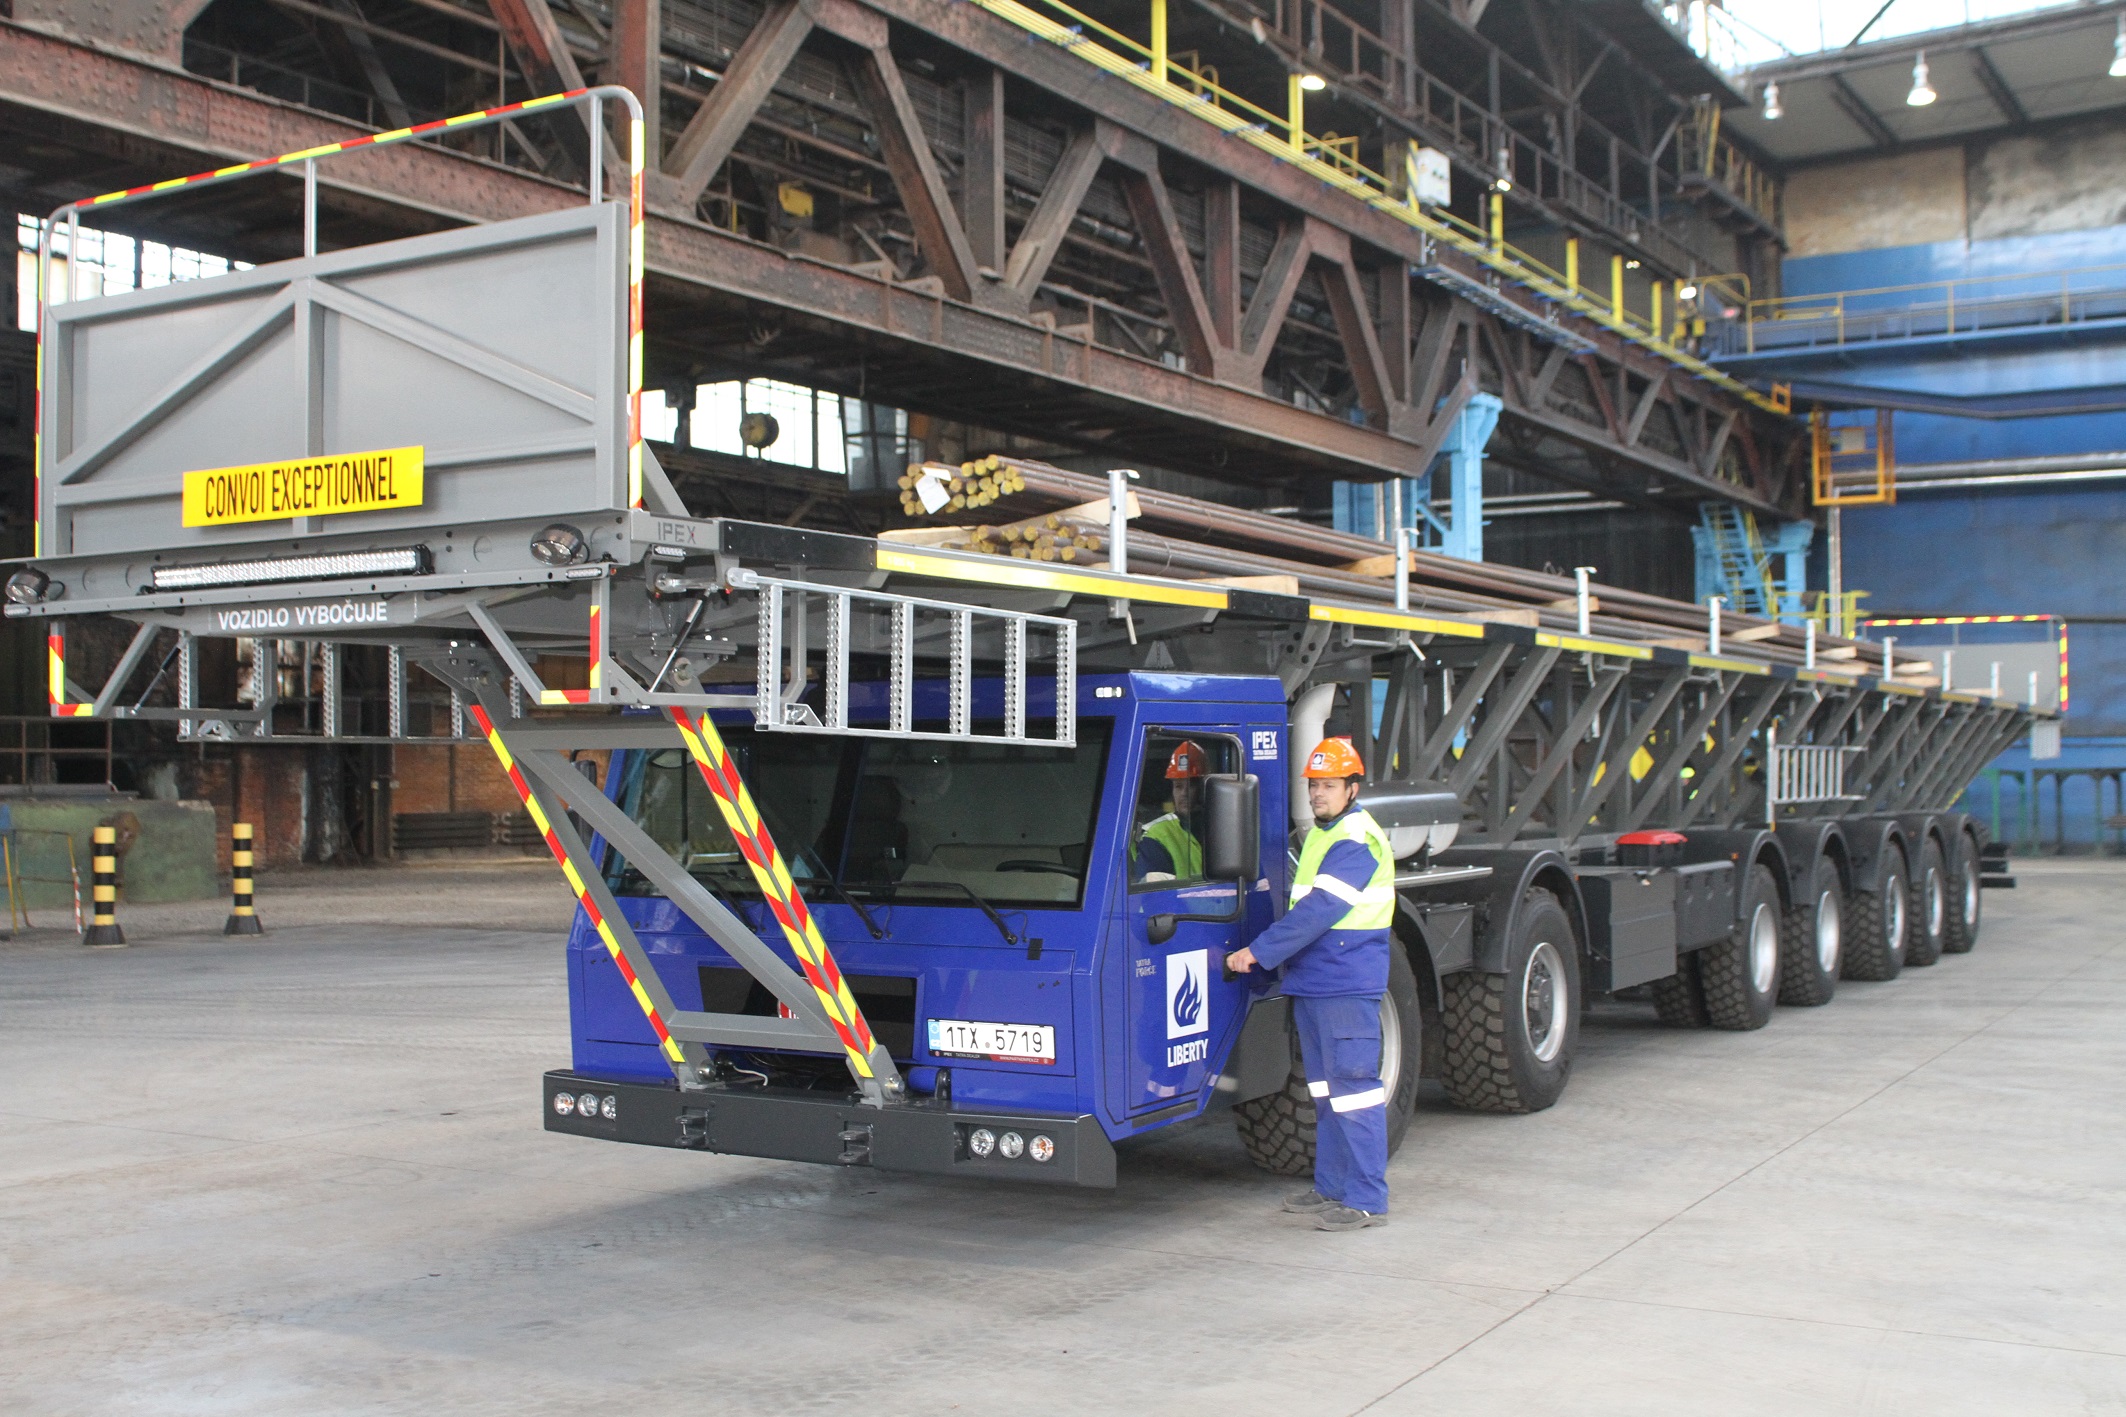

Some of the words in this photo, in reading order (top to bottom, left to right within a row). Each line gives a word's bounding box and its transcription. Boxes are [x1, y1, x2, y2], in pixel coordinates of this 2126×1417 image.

[205, 471, 265, 518] CONVOI
[272, 456, 397, 512] EXCEPTIONNEL
[658, 521, 696, 544] IPEX
[218, 608, 289, 630] VOZIDLO
[295, 599, 388, 626] VYBOČUJE
[1252, 731, 1277, 749] IPEX
[946, 1026, 979, 1049] 1TX
[995, 1029, 1043, 1053] 5719
[1167, 1038, 1209, 1068] LIBERTY
